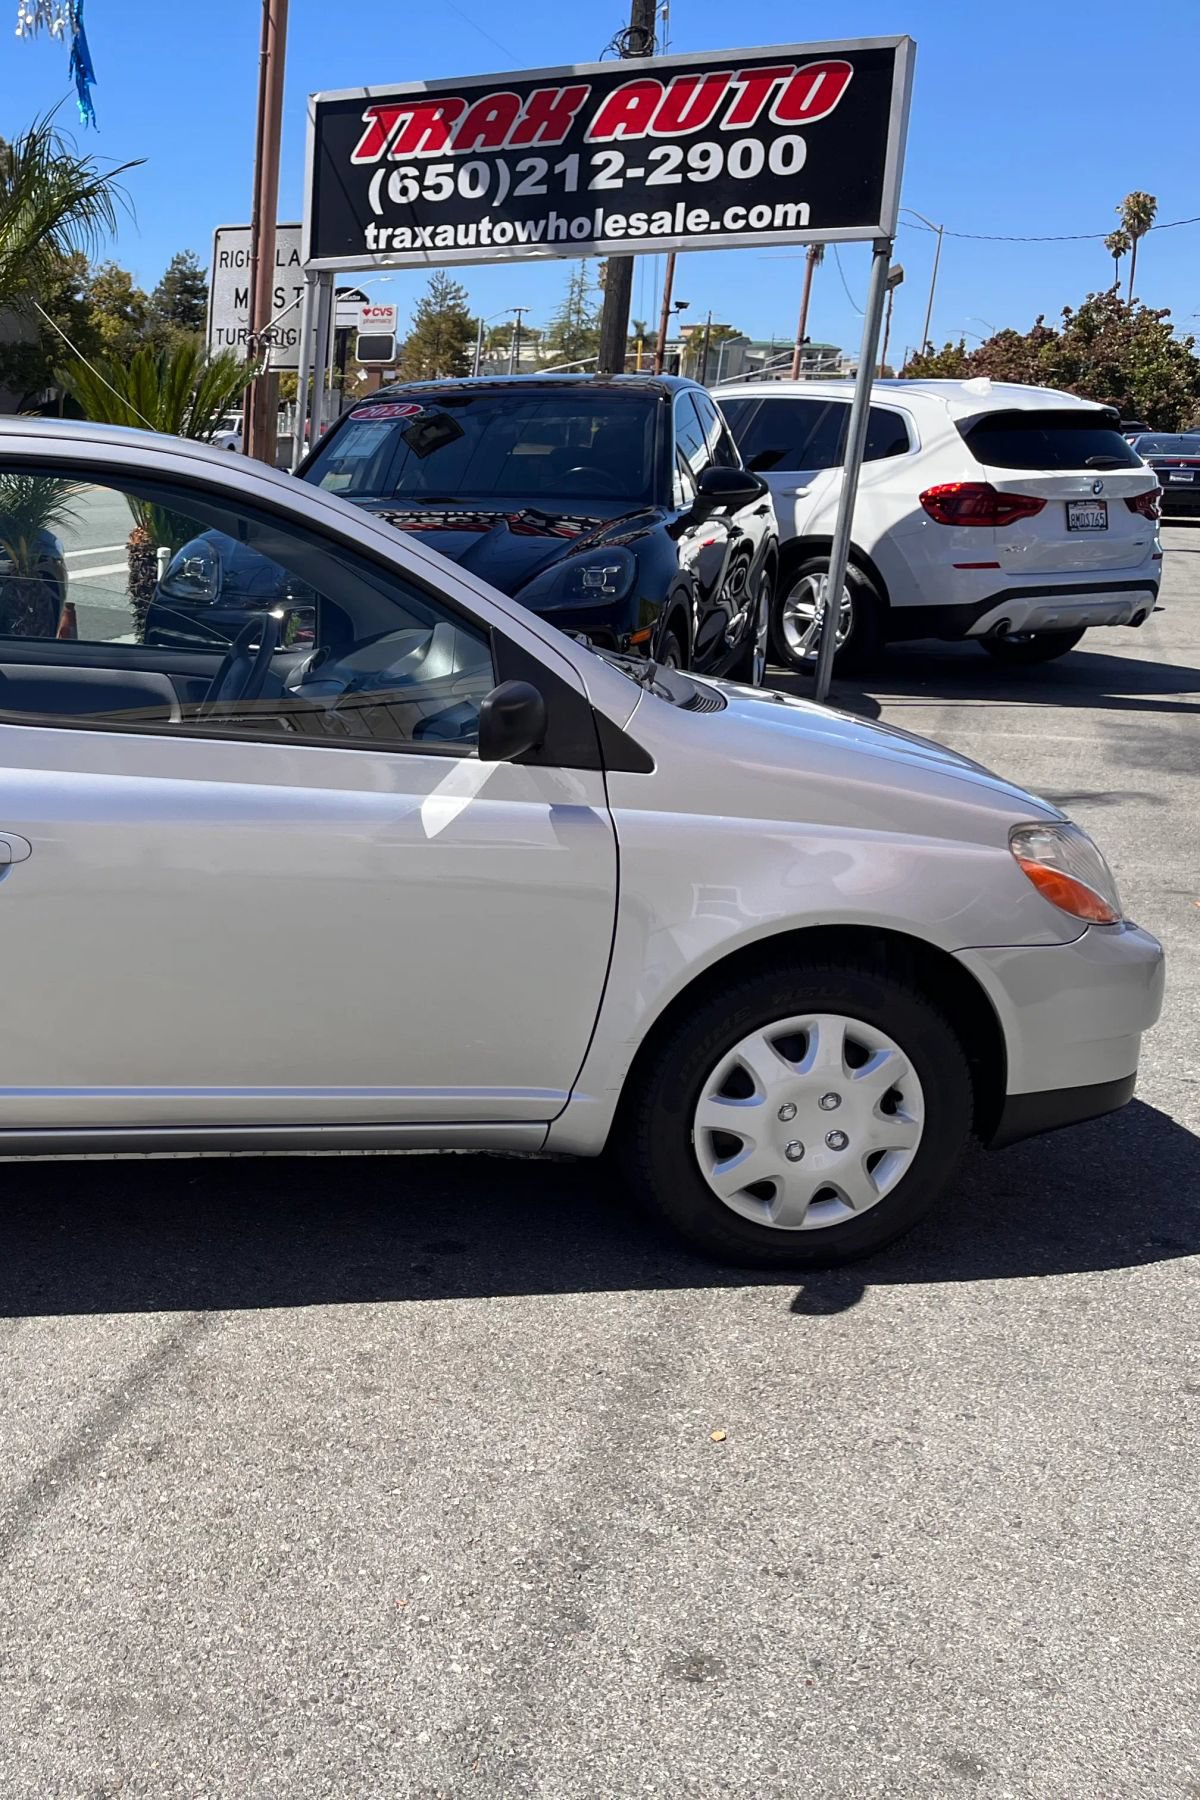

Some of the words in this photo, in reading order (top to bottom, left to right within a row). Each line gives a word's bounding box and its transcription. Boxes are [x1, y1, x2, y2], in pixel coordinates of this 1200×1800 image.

[350, 84, 592, 165] TRAX
[583, 60, 854, 143] AUTO
[367, 134, 807, 215] (650)212-2900
[364, 201, 811, 249] traxautowholesale.com
[275, 249, 302, 267] LA
[234, 286, 305, 309] MST
[372, 307, 394, 317] CVS
[216, 327, 248, 346] TUR
[358, 405, 413, 418] 2020
